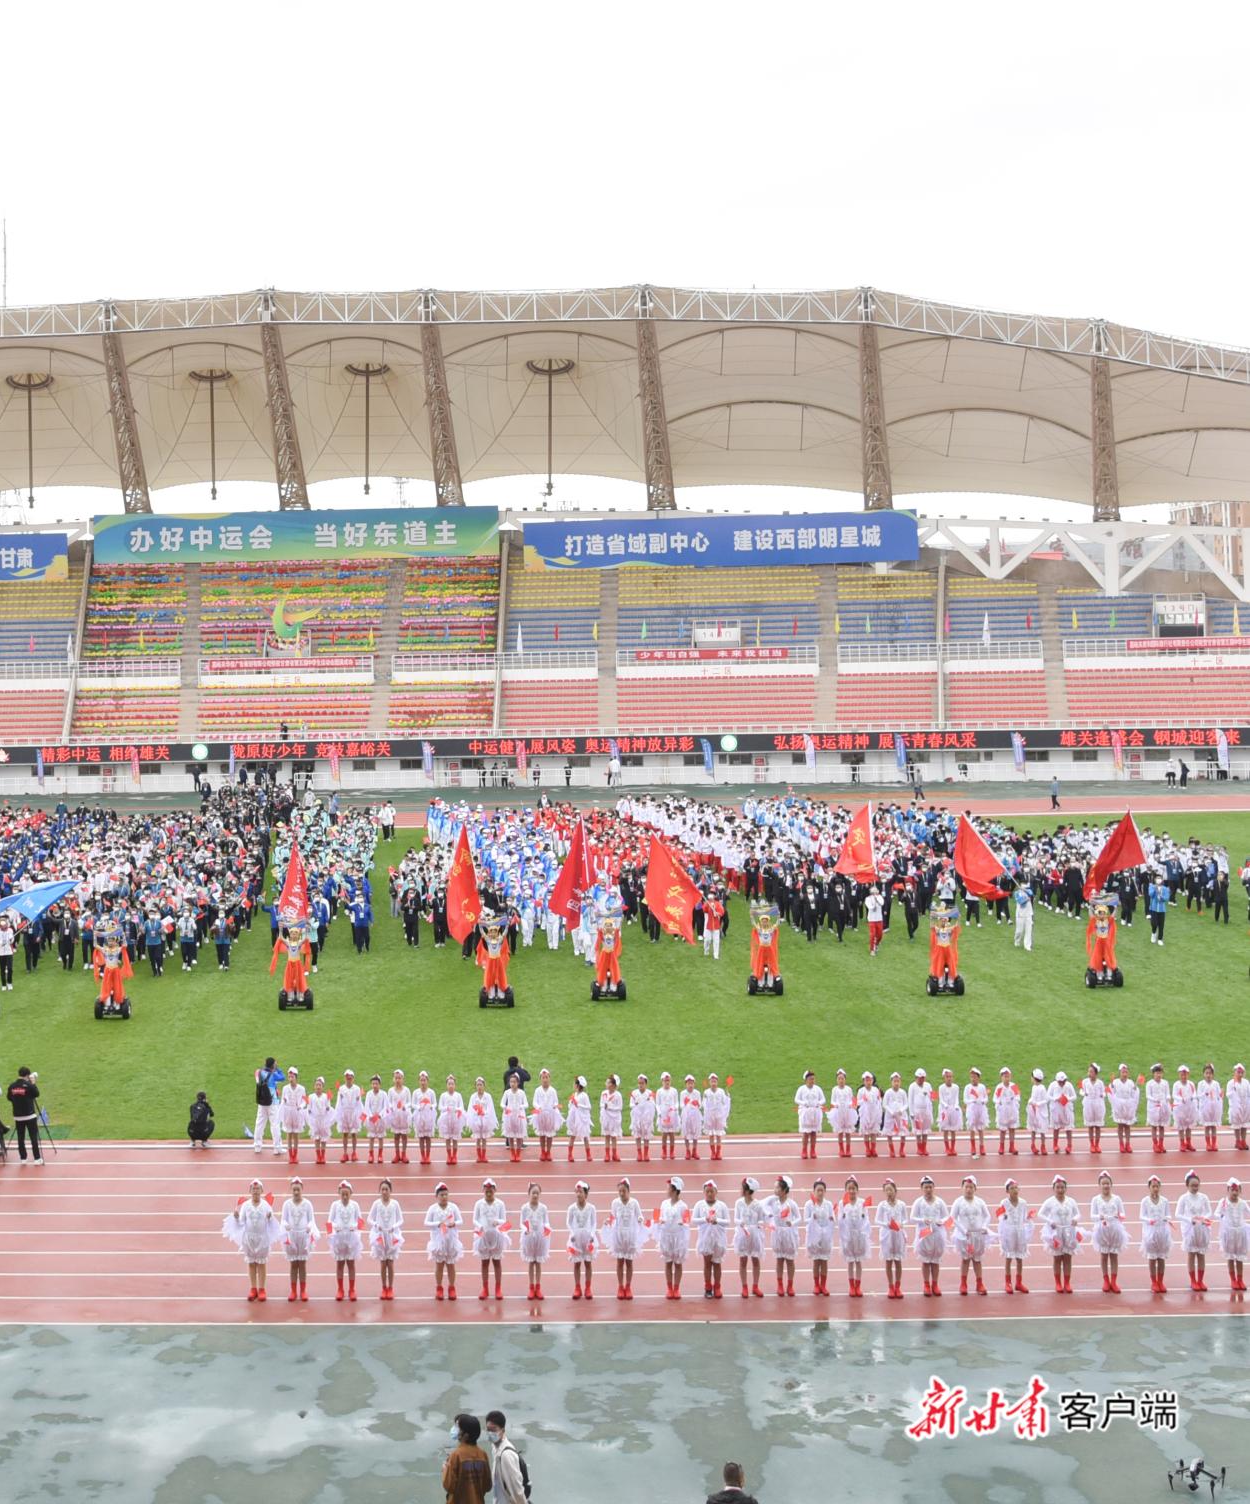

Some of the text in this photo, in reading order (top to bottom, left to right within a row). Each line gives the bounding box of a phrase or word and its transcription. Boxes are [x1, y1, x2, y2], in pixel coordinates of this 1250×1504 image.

[130, 521, 458, 552] 办好中运会 当好东道主
[564, 525, 882, 557] 打造省域副中心 建设西部明星城
[640, 649, 782, 659] 少年当自强 未来我担当
[701, 667, 732, 675] 十二区
[41, 746, 101, 763] 精彩中运
